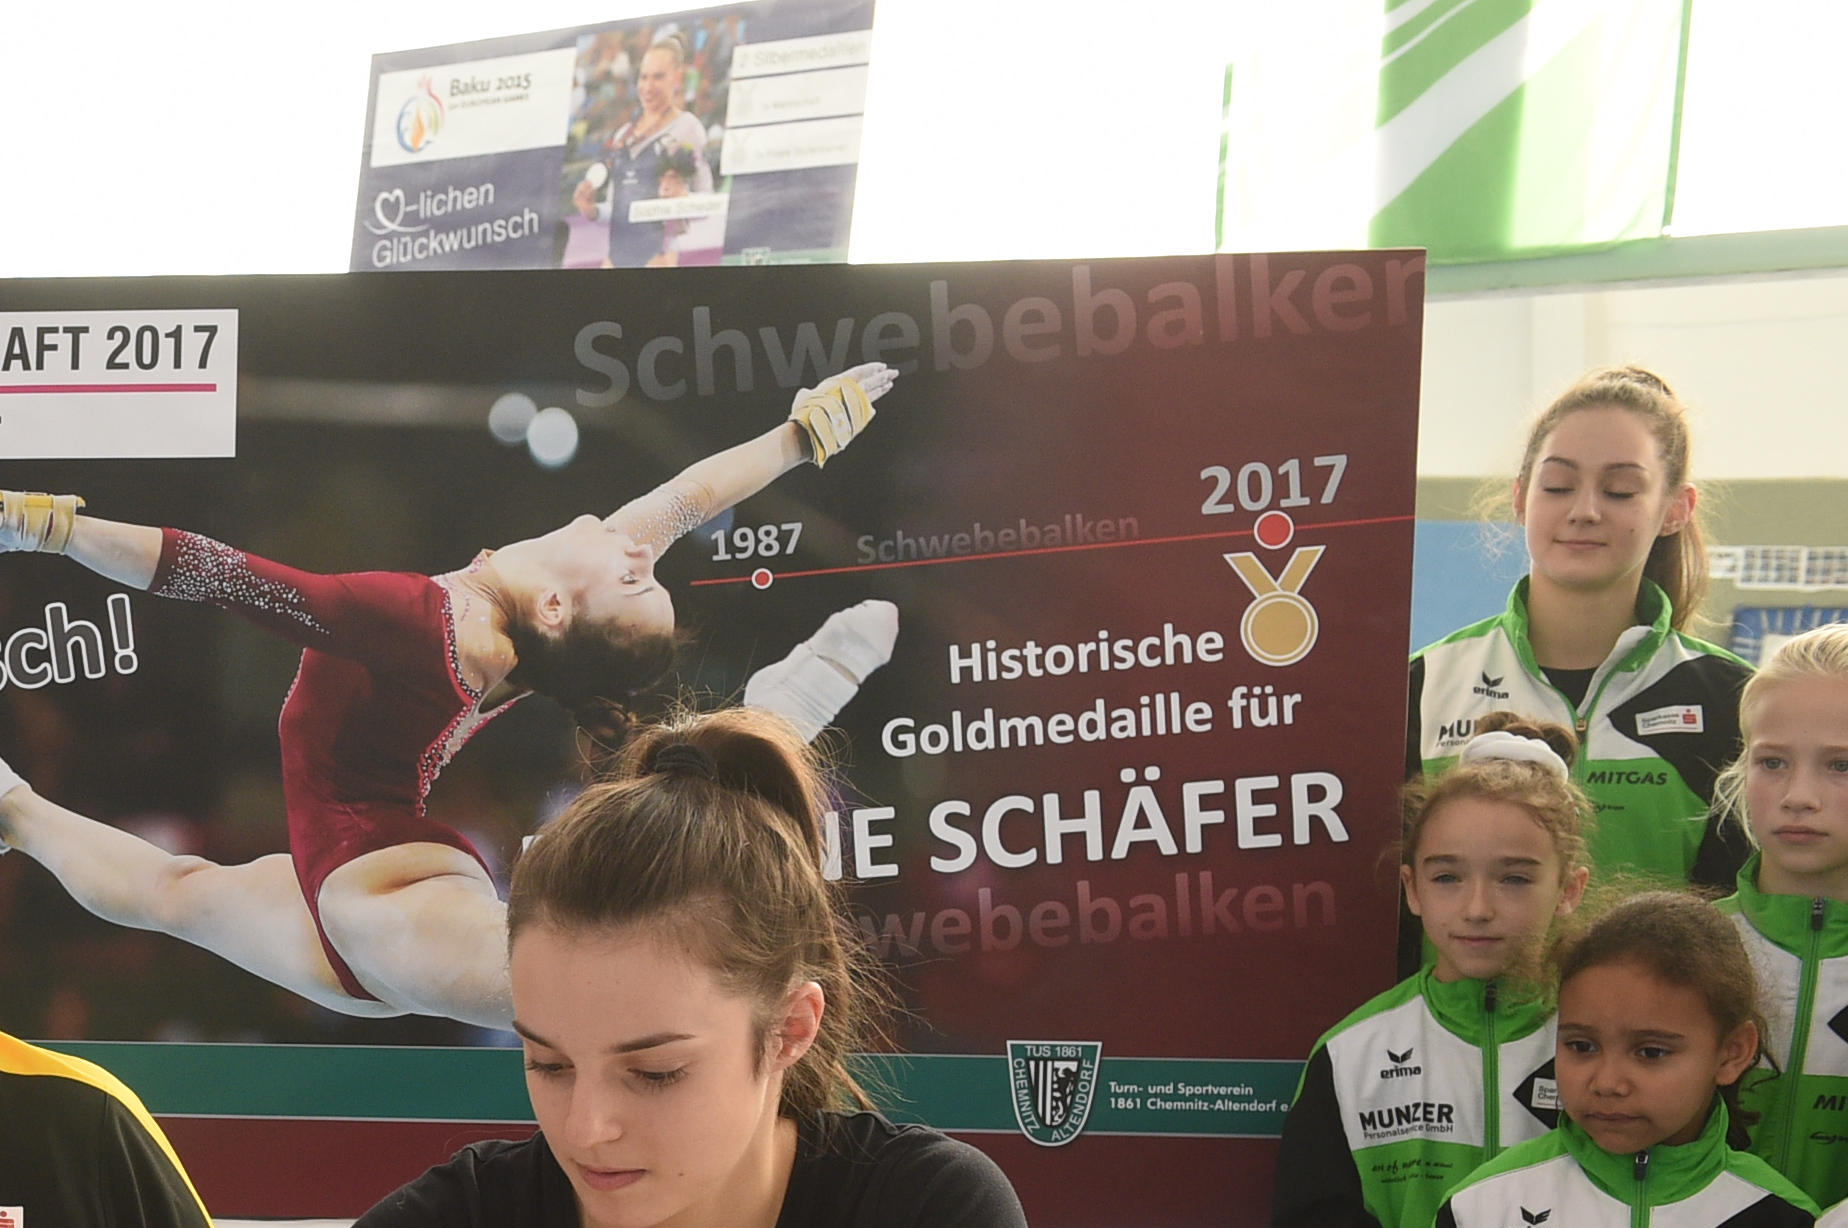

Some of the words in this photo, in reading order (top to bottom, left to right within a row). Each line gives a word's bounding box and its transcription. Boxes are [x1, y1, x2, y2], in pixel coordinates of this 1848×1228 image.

[449, 77, 490, 97] Baku
[495, 73, 532, 92] 2015
[404, 182, 495, 221] -lichen
[371, 207, 539, 269] Glückwunsch
[106, 323, 219, 371] 2017
[1199, 453, 1350, 516] 2017
[709, 521, 804, 564] 1987
[855, 509, 1141, 566] Schwebebalken
[948, 622, 1225, 685] Historische
[1473, 686, 1510, 700] erima
[881, 690, 1213, 758] Goldmedaille
[1227, 684, 1303, 729] für
[1586, 771, 1668, 786] MITGAS
[928, 766, 1351, 875] SCHÄFER
[1024, 1044, 1051, 1058] TUS
[1055, 1045, 1083, 1058] 1861
[1109, 1081, 1144, 1095] Turn-
[1147, 1081, 1174, 1095] und
[1177, 1082, 1254, 1097] Sportverein
[1380, 1064, 1422, 1080] erima
[1012, 1057, 1041, 1134] CHEMNITZ
[1051, 1058, 1095, 1142] ALTENDORF
[1109, 1097, 1142, 1110] 1861
[1146, 1097, 1277, 1112] Chemnitz-Altendorf
[1358, 1101, 1455, 1132] MUNZER
[1425, 1123, 1454, 1133] GmbH
